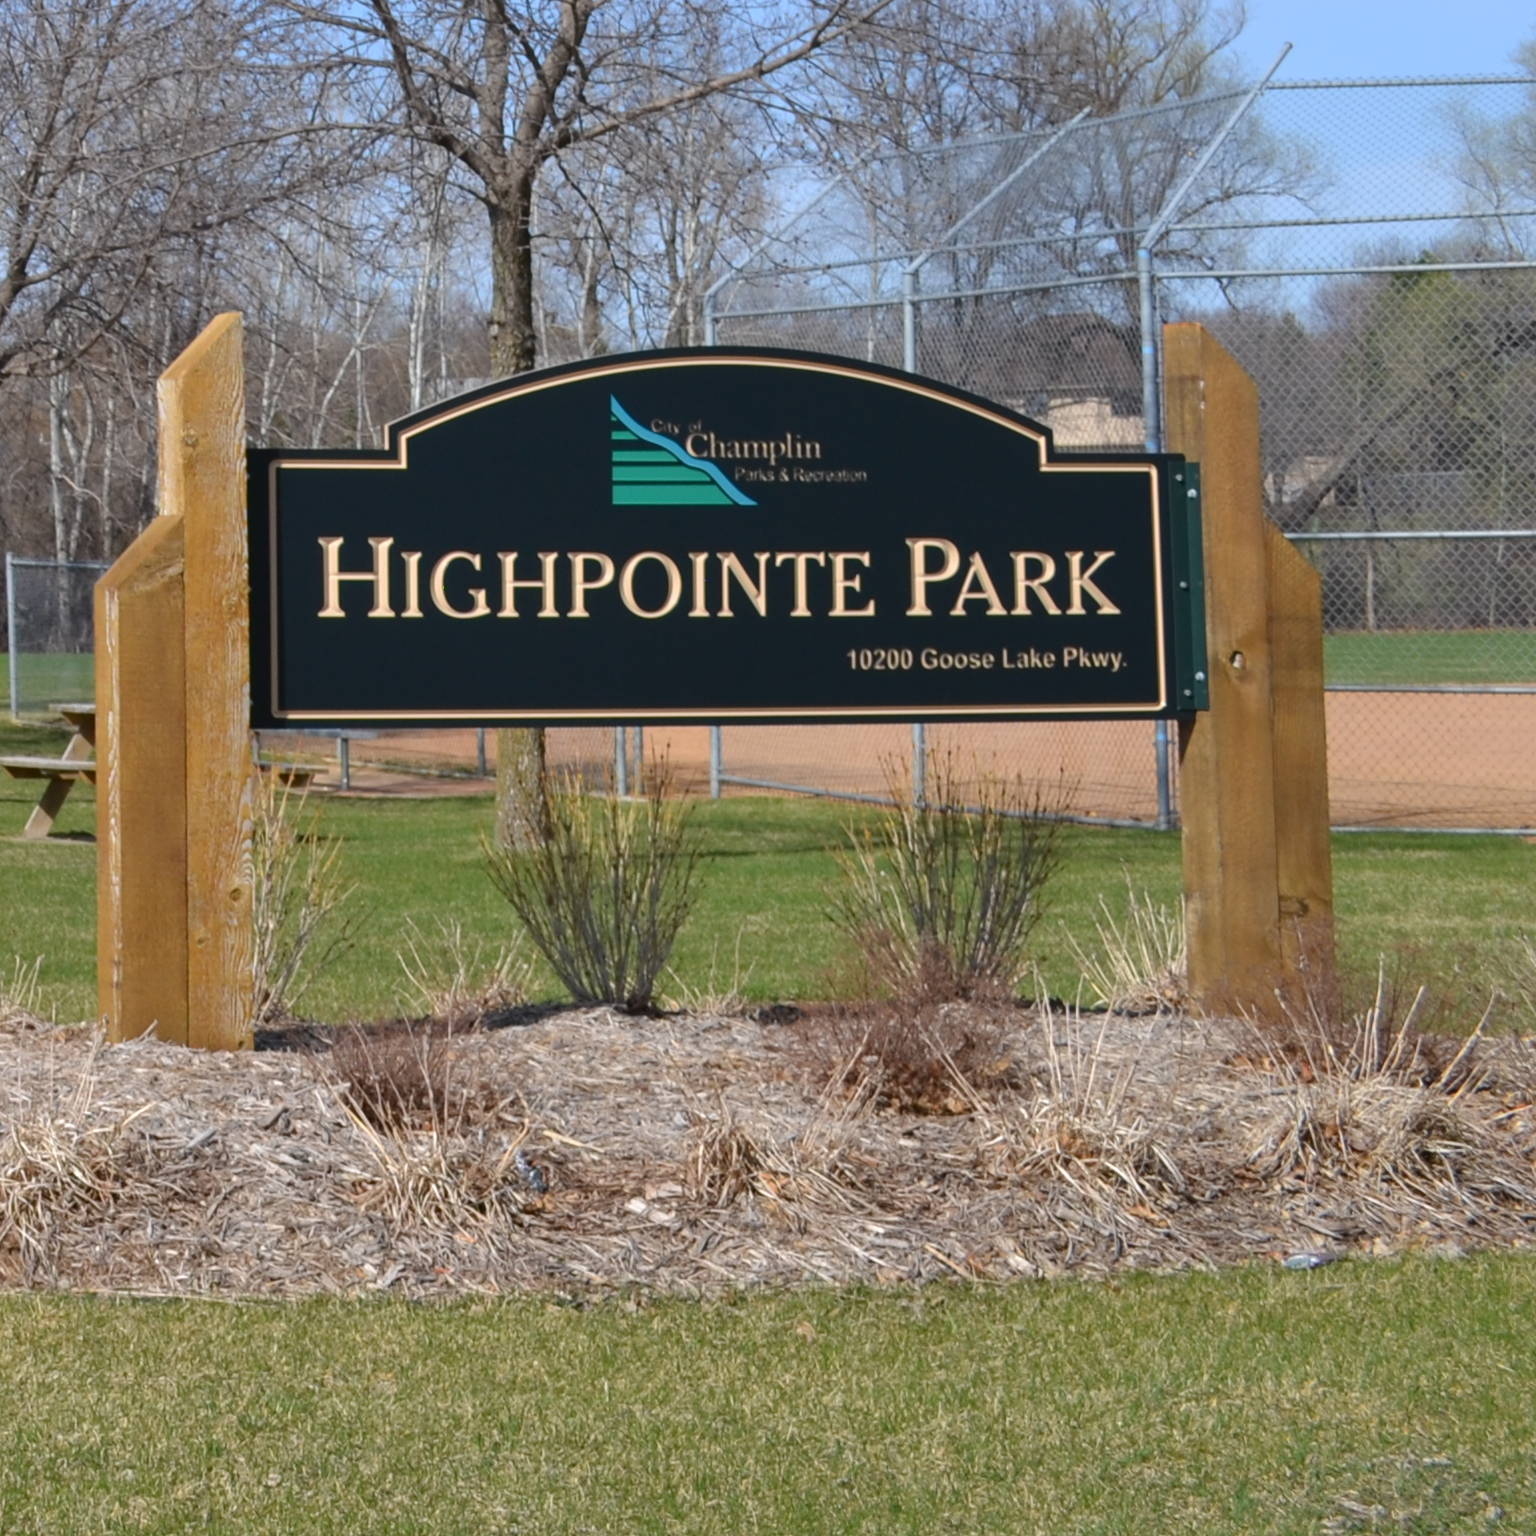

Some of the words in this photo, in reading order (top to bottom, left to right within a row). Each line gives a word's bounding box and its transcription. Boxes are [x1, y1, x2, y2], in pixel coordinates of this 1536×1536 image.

[650, 418, 679, 434] City
[688, 419, 702, 432] of
[685, 431, 822, 466] Champlin
[734, 467, 775, 482] Parks
[779, 468, 790, 482] &
[793, 467, 867, 482] Recreation
[316, 535, 876, 620] HIGHPOINTE
[904, 536, 1122, 618] PARK
[847, 648, 914, 670] 10200
[920, 648, 995, 670] Goose
[1002, 647, 1056, 669] Lake
[1063, 647, 1127, 672] Pkwy.
